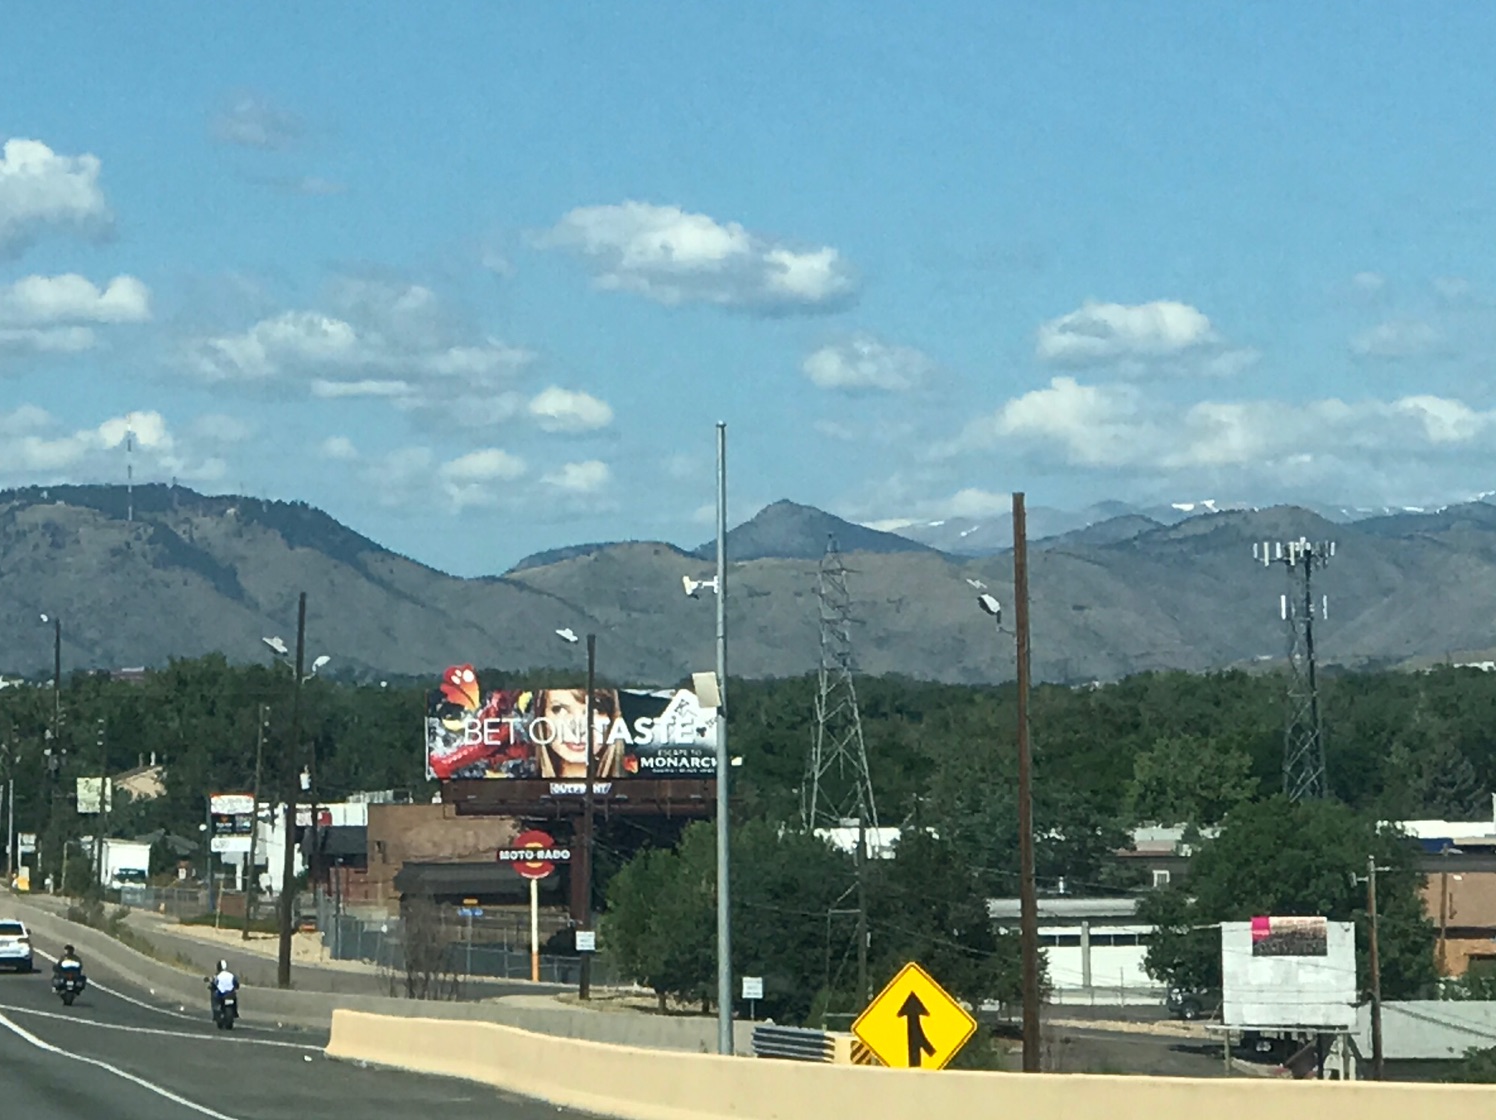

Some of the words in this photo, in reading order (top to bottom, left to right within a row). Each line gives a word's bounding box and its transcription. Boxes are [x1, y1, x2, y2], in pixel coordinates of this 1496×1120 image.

[463, 718, 518, 746] BET
[529, 717, 588, 746] ON
[592, 716, 697, 746] TASTE
